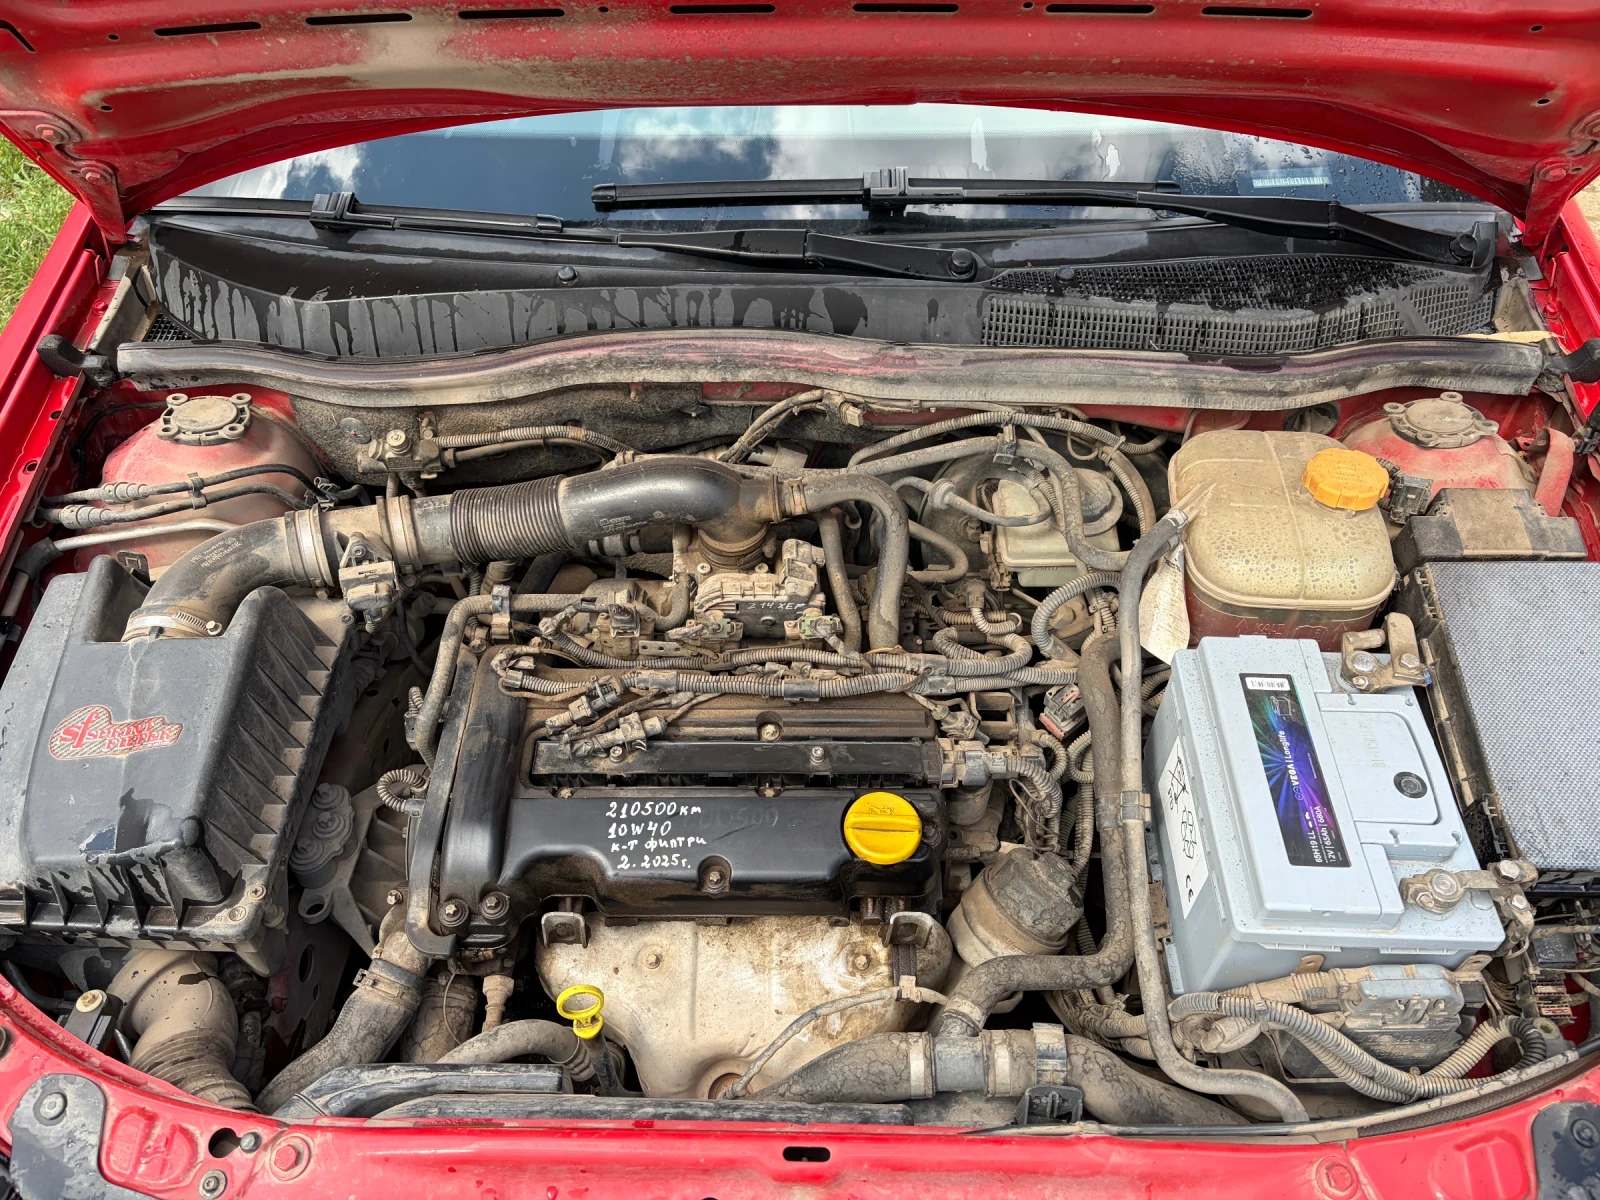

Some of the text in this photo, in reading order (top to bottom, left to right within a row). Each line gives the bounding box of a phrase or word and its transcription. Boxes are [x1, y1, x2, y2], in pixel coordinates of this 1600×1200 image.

[1278, 730, 1292, 759] Longlife
[1310, 840, 1323, 863] 65H19
[1326, 849, 1337, 862] 12V
